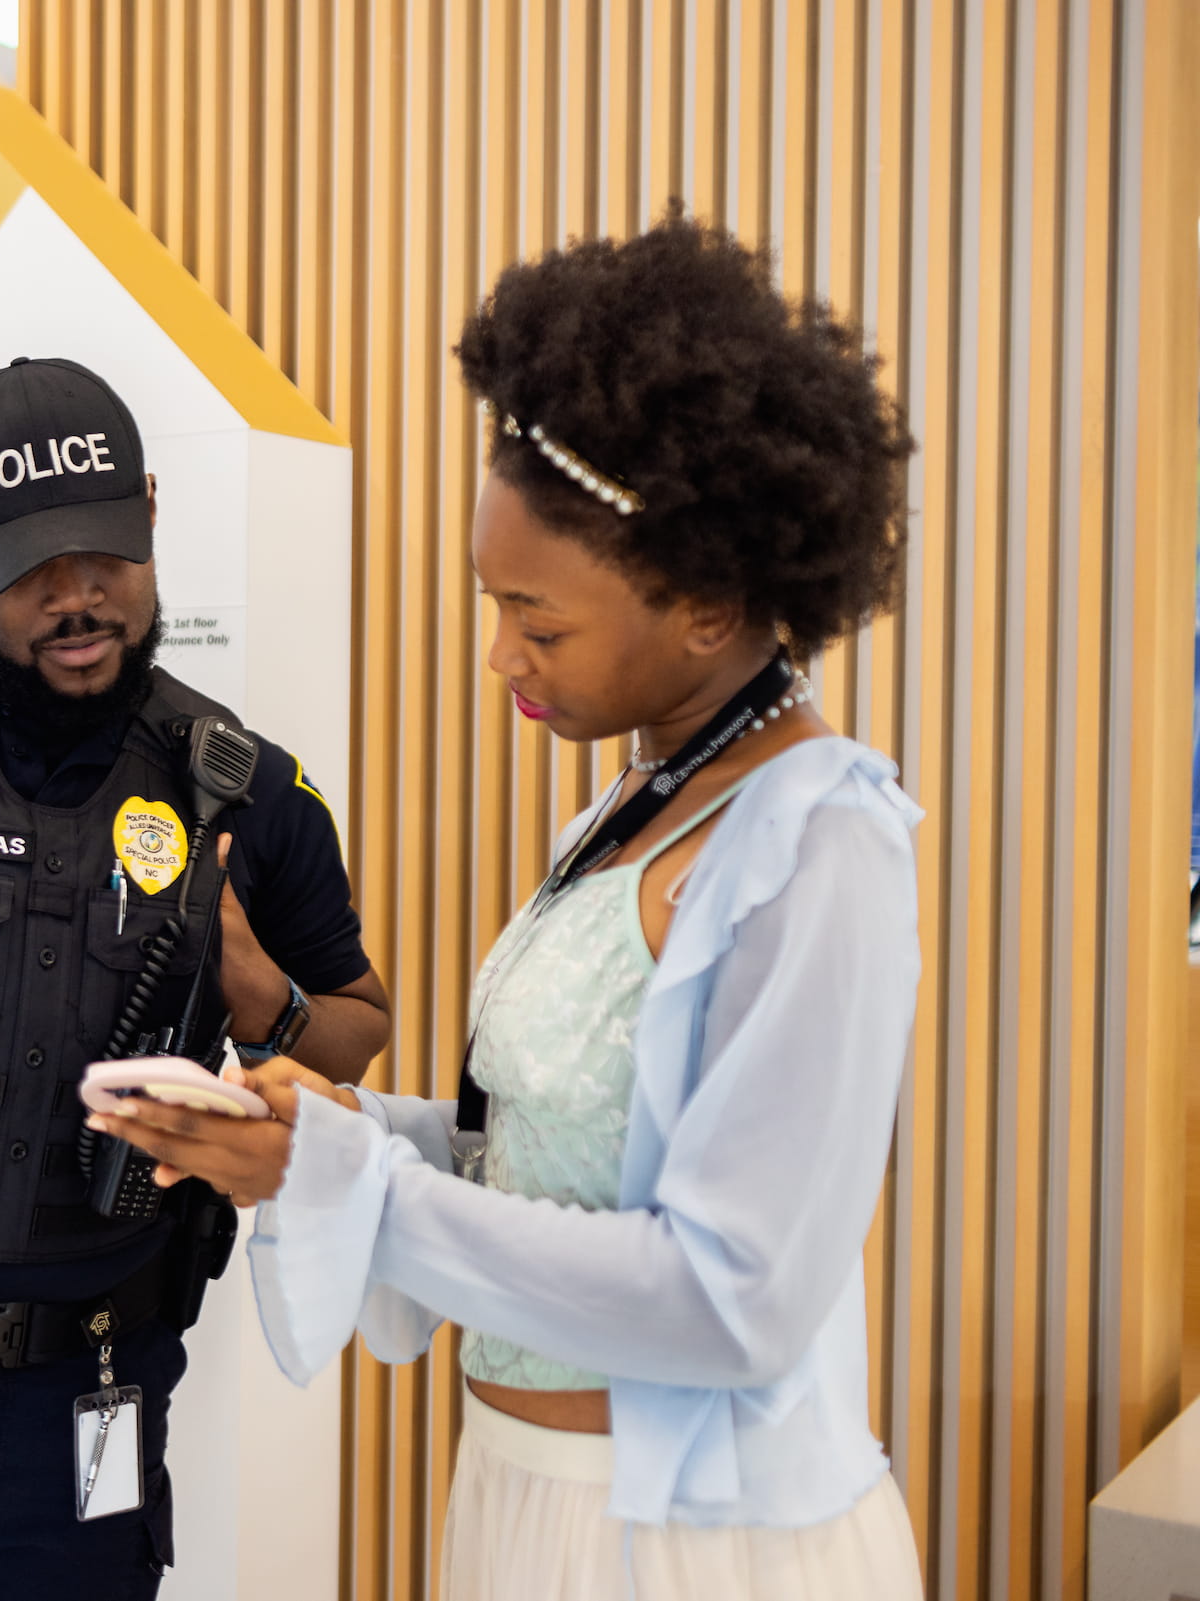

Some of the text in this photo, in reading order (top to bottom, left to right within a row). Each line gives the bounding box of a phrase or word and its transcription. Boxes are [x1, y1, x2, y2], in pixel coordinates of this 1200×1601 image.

[174, 618, 190, 629] 1st
[193, 616, 218, 628] floor
[206, 634, 230, 647] Only
[673, 707, 755, 783] CENTRAL PIEDMONT
[125, 846, 177, 865] SPECIAL POLICE
[145, 868, 159, 878] NC
